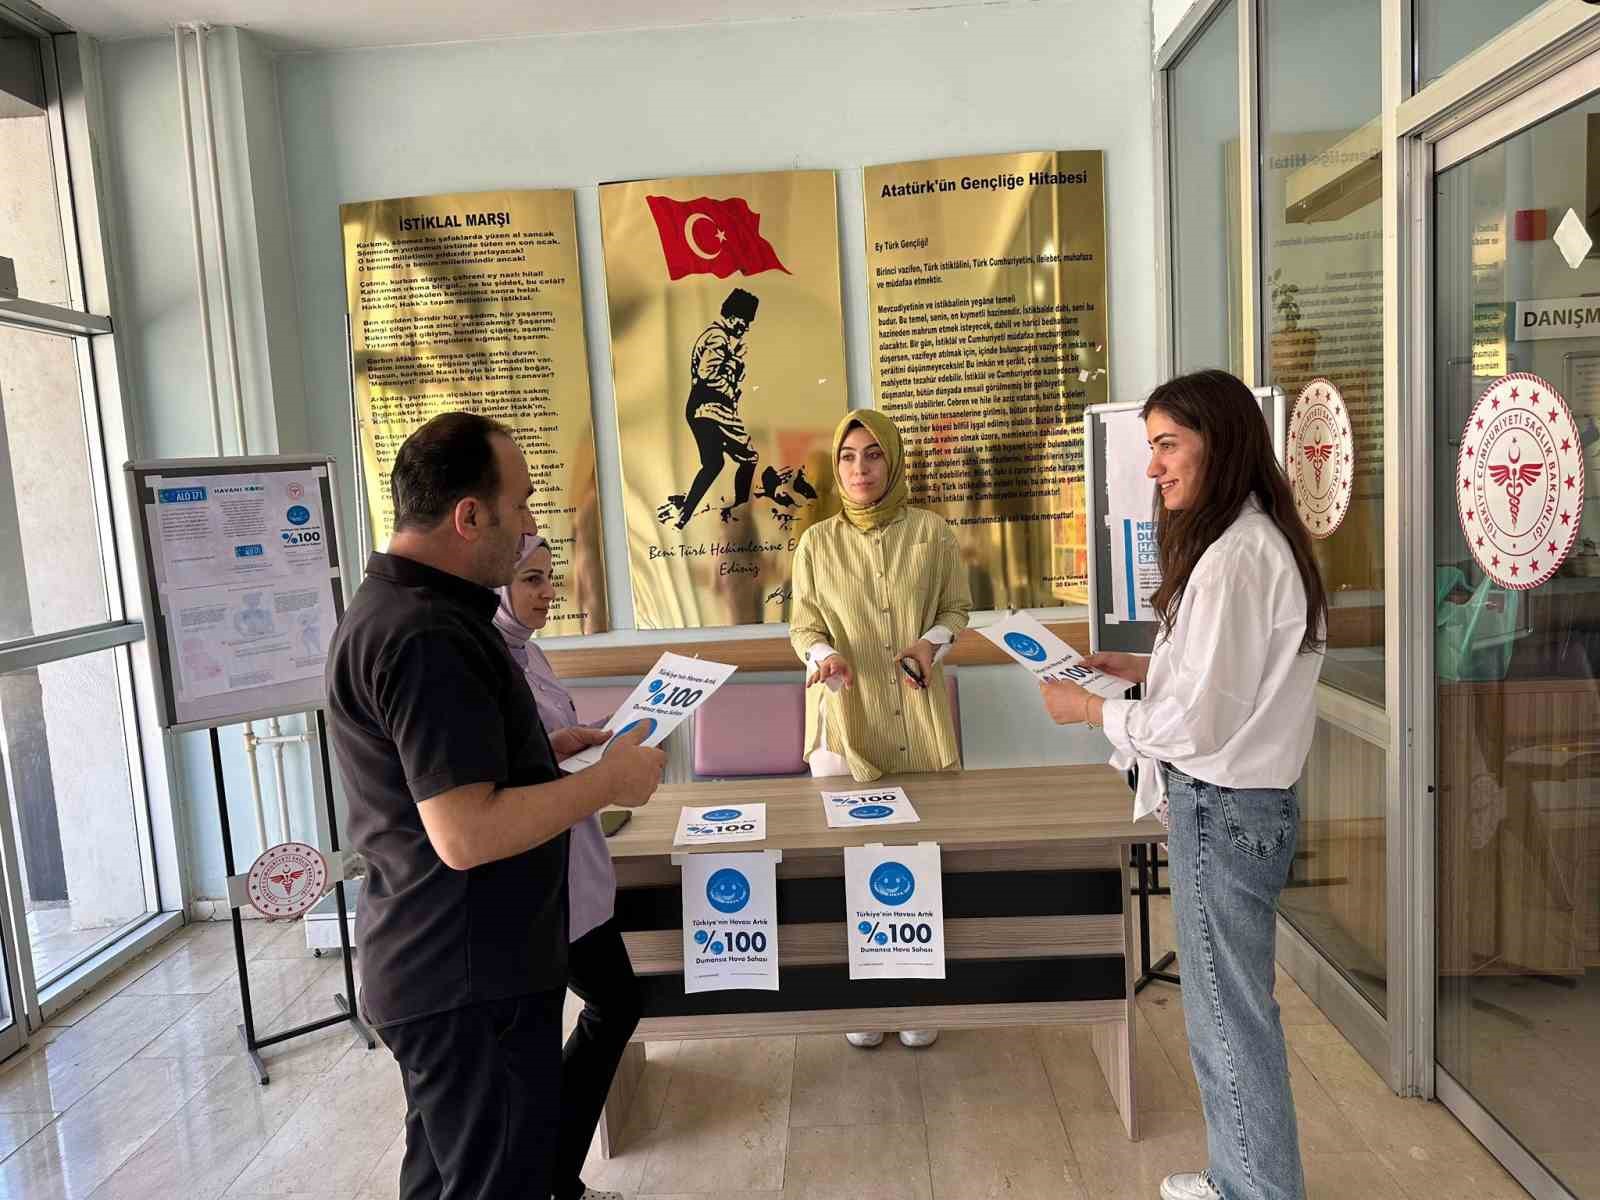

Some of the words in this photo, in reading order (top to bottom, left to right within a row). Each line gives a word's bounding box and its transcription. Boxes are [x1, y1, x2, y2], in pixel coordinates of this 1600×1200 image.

[881, 179, 956, 198] Atatürk'ün
[961, 174, 1024, 191] Gençliğe
[1029, 170, 1087, 185] Hitabesi
[400, 214, 461, 232] İSTİKLAL
[465, 212, 510, 228] MARŞI
[875, 243, 883, 253] Ey
[884, 241, 899, 250] Türk
[876, 267, 896, 276] Birinci
[924, 263, 939, 272] Türk
[1524, 308, 1600, 328] DANIŞM
[1525, 416, 1554, 458] SAĞLIK
[649, 545, 675, 560] Beni
[679, 544, 706, 558] Türk
[694, 930, 767, 955] %100
[858, 921, 932, 945] %100
